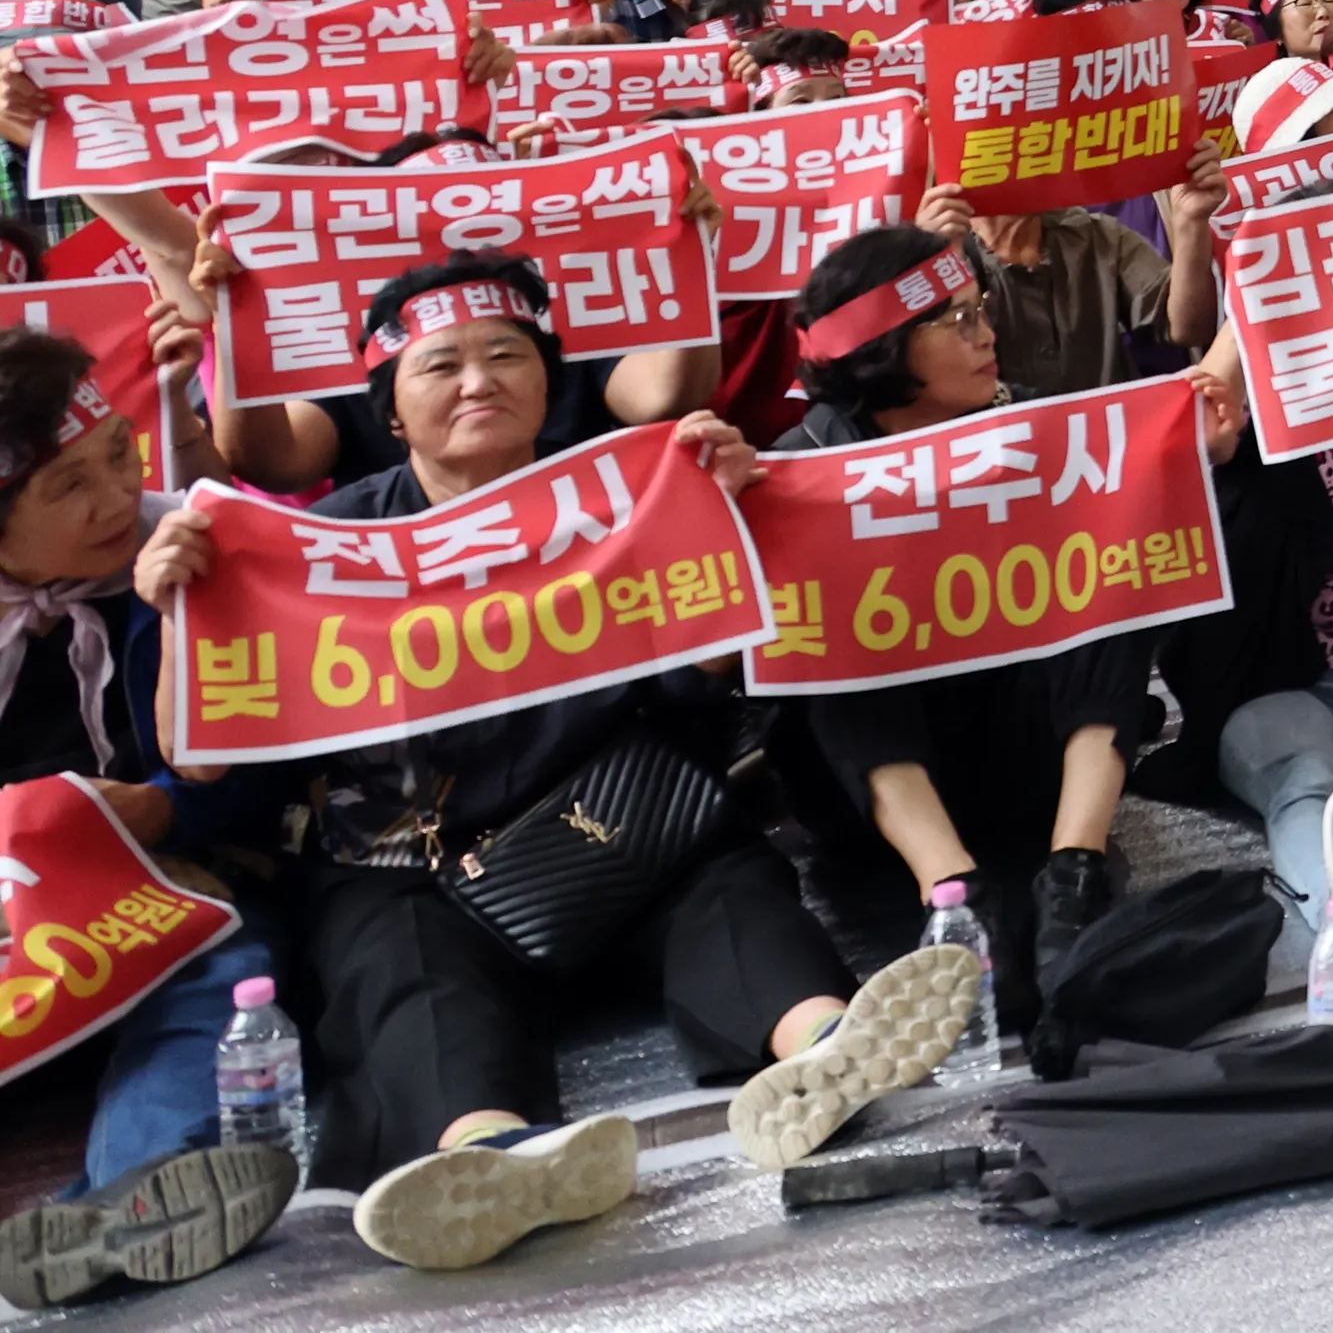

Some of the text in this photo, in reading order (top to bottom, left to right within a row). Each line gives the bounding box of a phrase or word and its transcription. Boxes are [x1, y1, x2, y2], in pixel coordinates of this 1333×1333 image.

[65, 80, 458, 170] 물러가라!
[953, 35, 1170, 122] 완주를 지키자!
[960, 95, 1181, 189] 통합반대!
[898, 251, 968, 311] 통합
[292, 454, 634, 597] 전주시
[844, 400, 1127, 541] 전주시
[197, 550, 744, 722] 빚 6,000억원!
[762, 524, 1209, 658] 빚 6,000억원!
